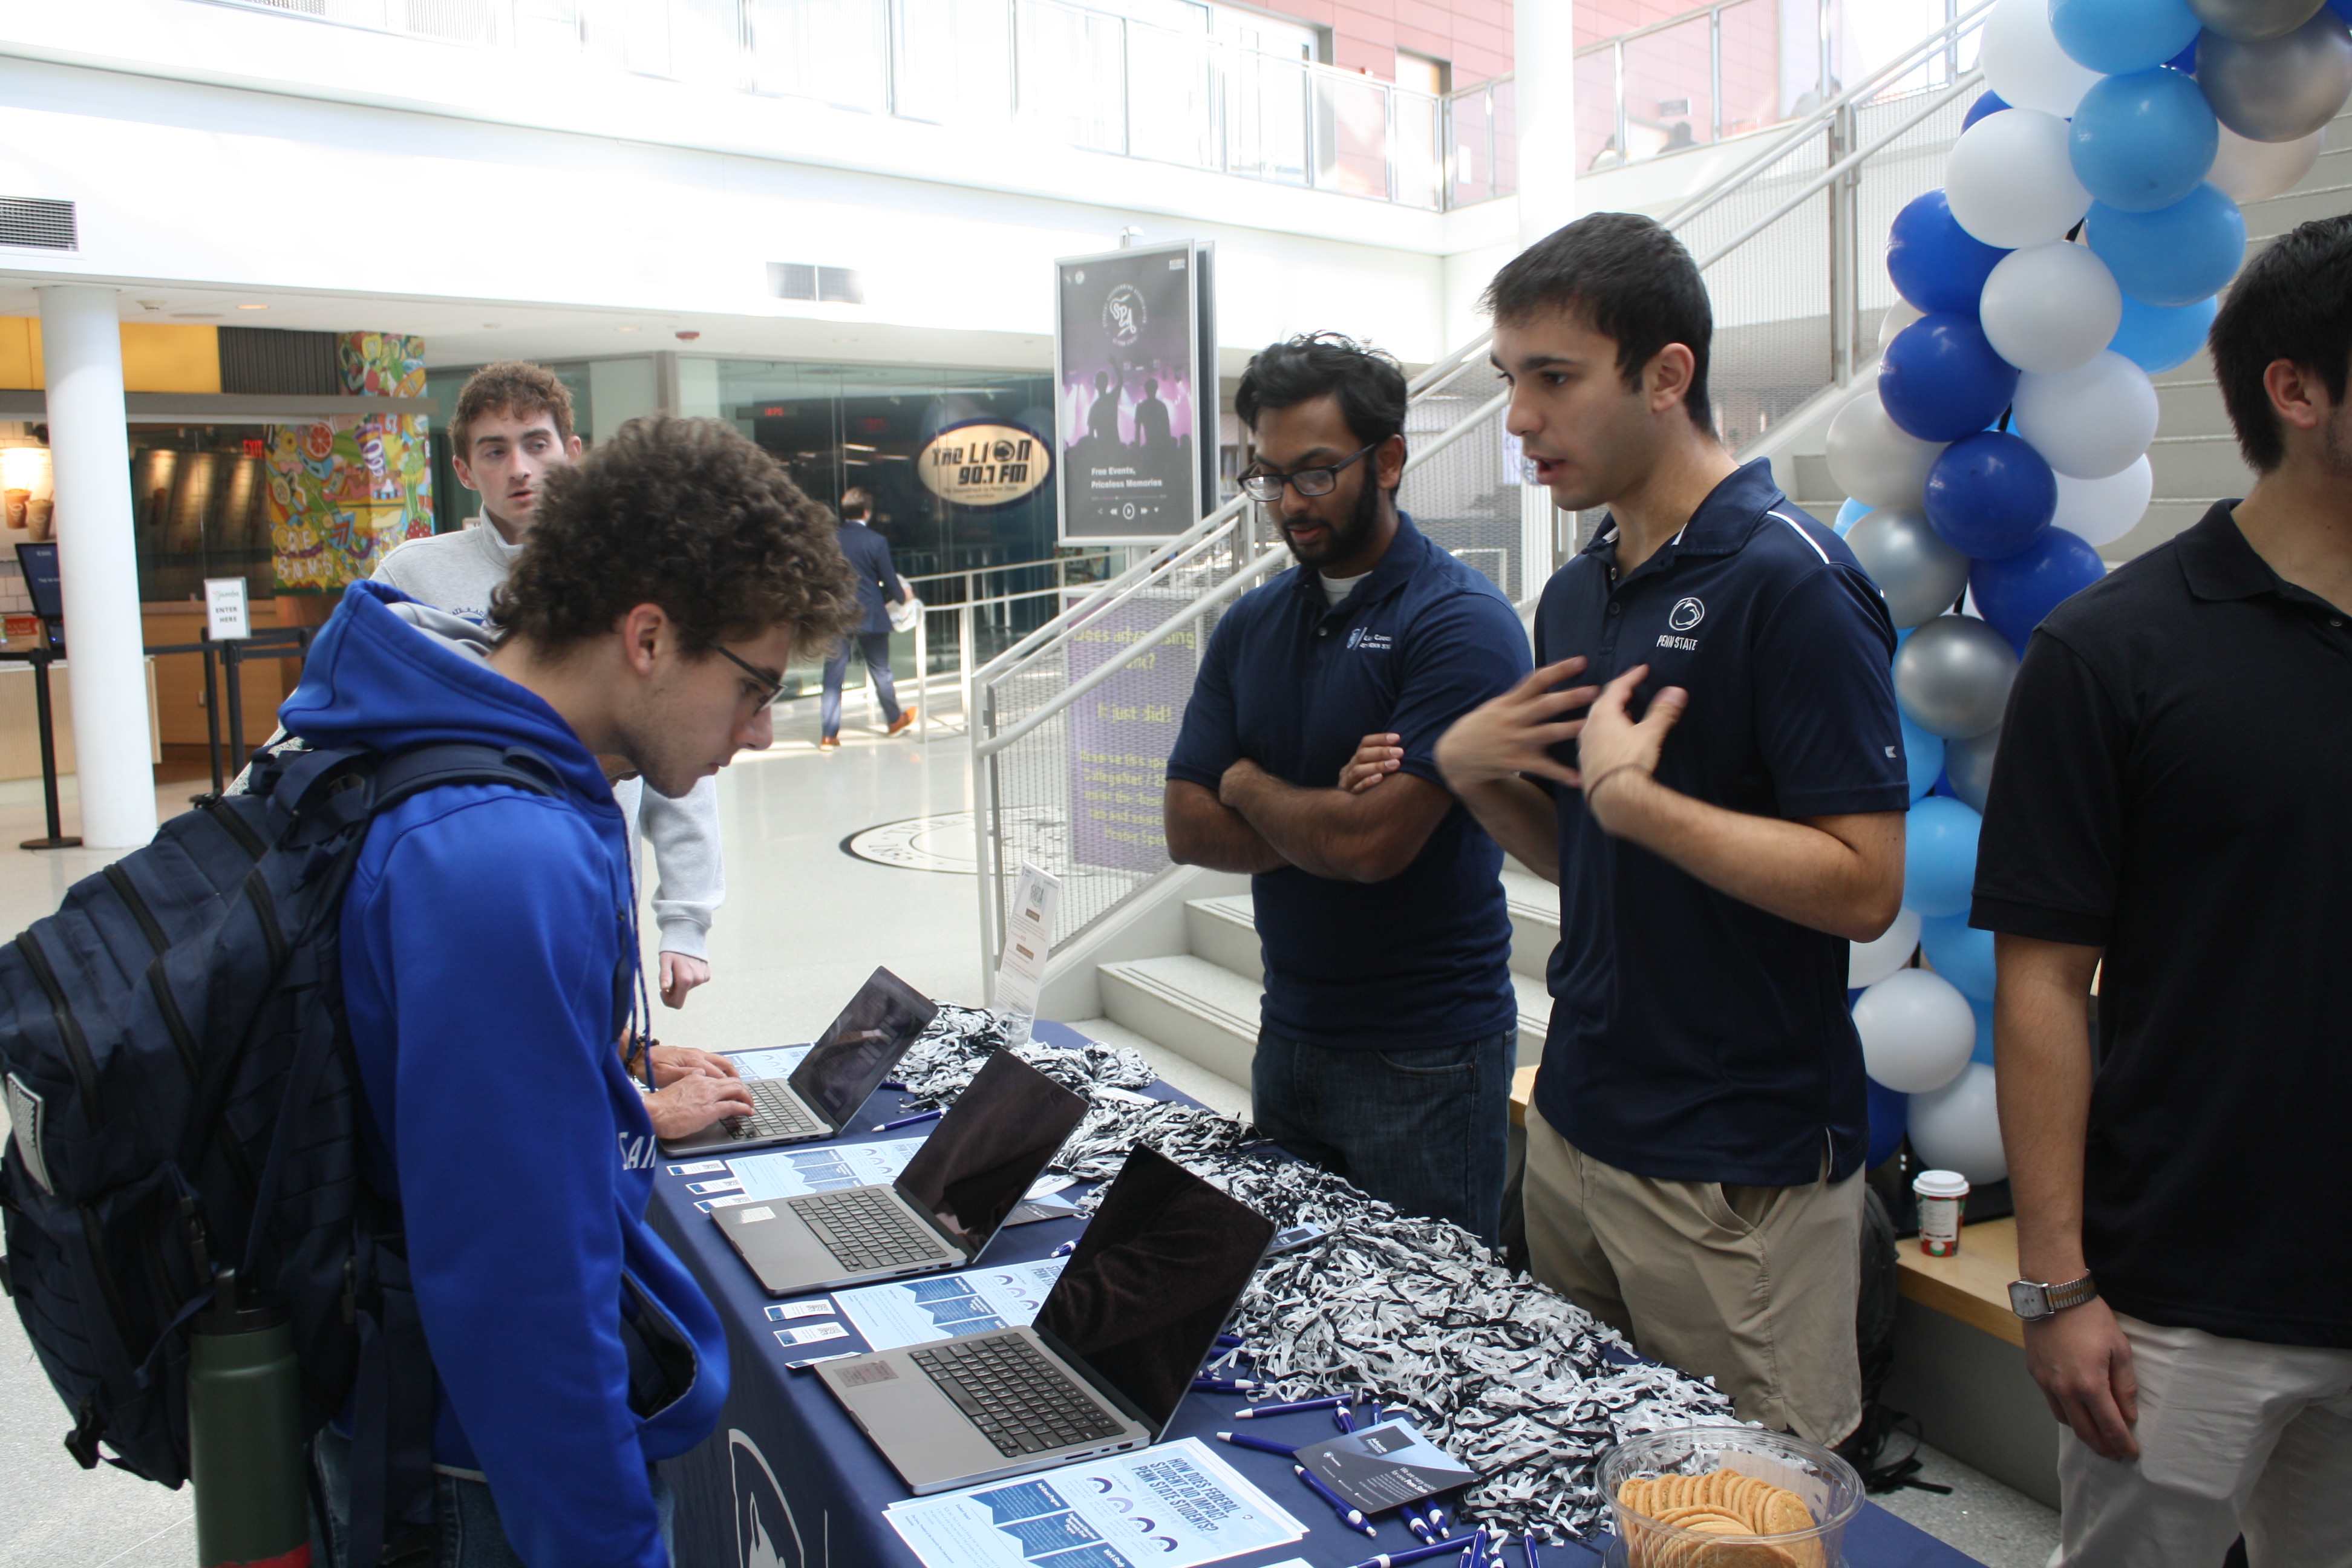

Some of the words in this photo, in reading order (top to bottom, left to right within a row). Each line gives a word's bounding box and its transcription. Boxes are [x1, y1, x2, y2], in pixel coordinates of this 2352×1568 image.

[243, 440, 264, 459] EXIT
[958, 465, 995, 485] 90.7
[1091, 467, 1106, 475] Free
[1108, 466, 1135, 475] Events,
[1091, 480, 1125, 489] Priceless
[1126, 479, 1162, 487] Memories
[1656, 635, 1675, 648] PENN
[1674, 636, 1698, 650] STATE
[1111, 703, 1137, 723] just
[1371, 1437, 1388, 1452] Advocate
[1148, 1461, 1189, 1487] STUDENT
[1176, 1486, 1201, 1498] AID
[1189, 1497, 1230, 1521] IMPACT
[1166, 1457, 1195, 1473] HOW
[1183, 1472, 1213, 1488] DOES
[1200, 1487, 1241, 1513] FEDERAL
[1404, 1479, 1417, 1488] Penn
[1415, 1485, 1428, 1494] State
[1040, 1487, 1052, 1495] Grant
[1047, 1494, 1062, 1508] Program
[1131, 1465, 1161, 1482] PENN
[1148, 1481, 1181, 1500] STATE
[1168, 1499, 1220, 1531] STUDENTS?
[1062, 1524, 1077, 1534] Program
[1102, 1548, 1117, 1558] Work
[1111, 1557, 1126, 1567] Study
